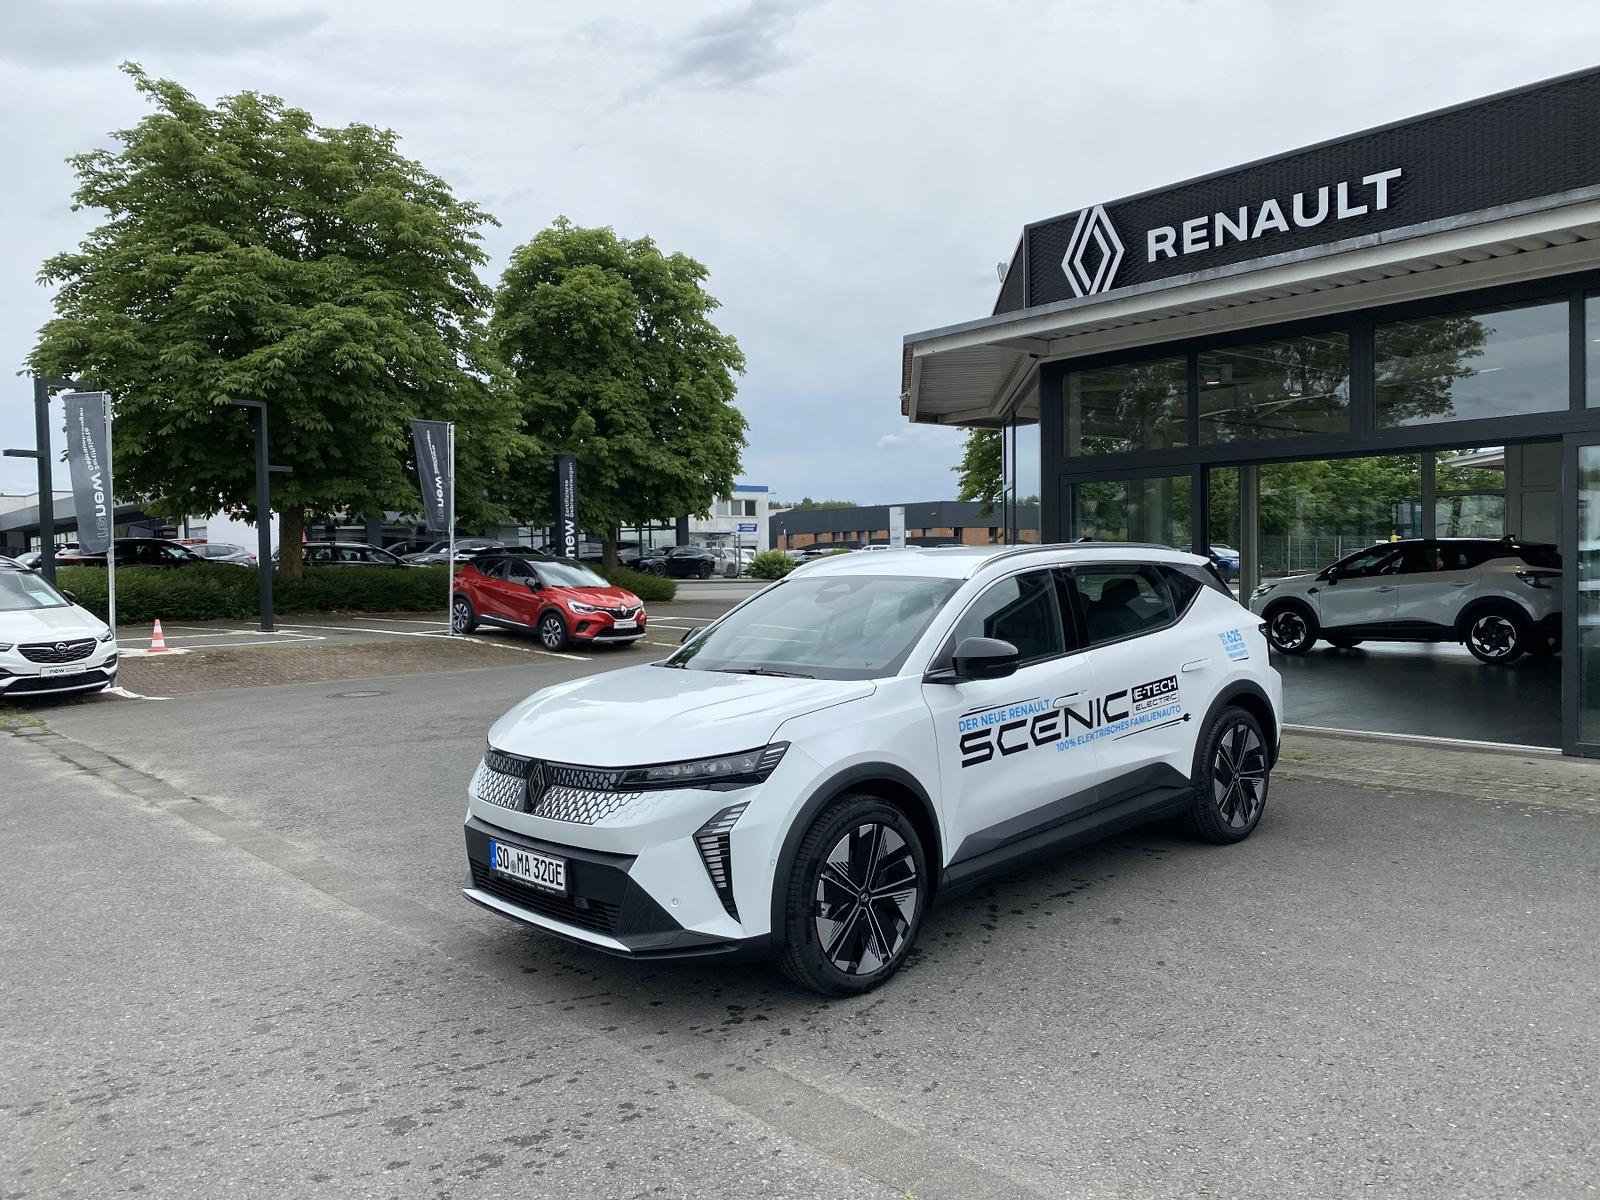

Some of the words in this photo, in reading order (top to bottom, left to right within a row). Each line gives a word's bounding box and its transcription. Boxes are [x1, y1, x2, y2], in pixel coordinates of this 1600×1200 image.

[1147, 168, 1402, 263] RENAULT
[1227, 629, 1242, 643] 625
[958, 717, 979, 732] DER
[980, 710, 1007, 728] NEUE
[1009, 699, 1051, 720] RENAULT
[1135, 692, 1178, 712] ELECTRIC
[959, 689, 1129, 768] SCENIC
[1056, 738, 1078, 753] 100%
[1077, 720, 1131, 746] ELEKTRISCHES
[1130, 704, 1182, 728] FAMILIENAUTO
[496, 846, 510, 870] SO
[516, 852, 531, 877] MA
[533, 857, 564, 887] 320E
